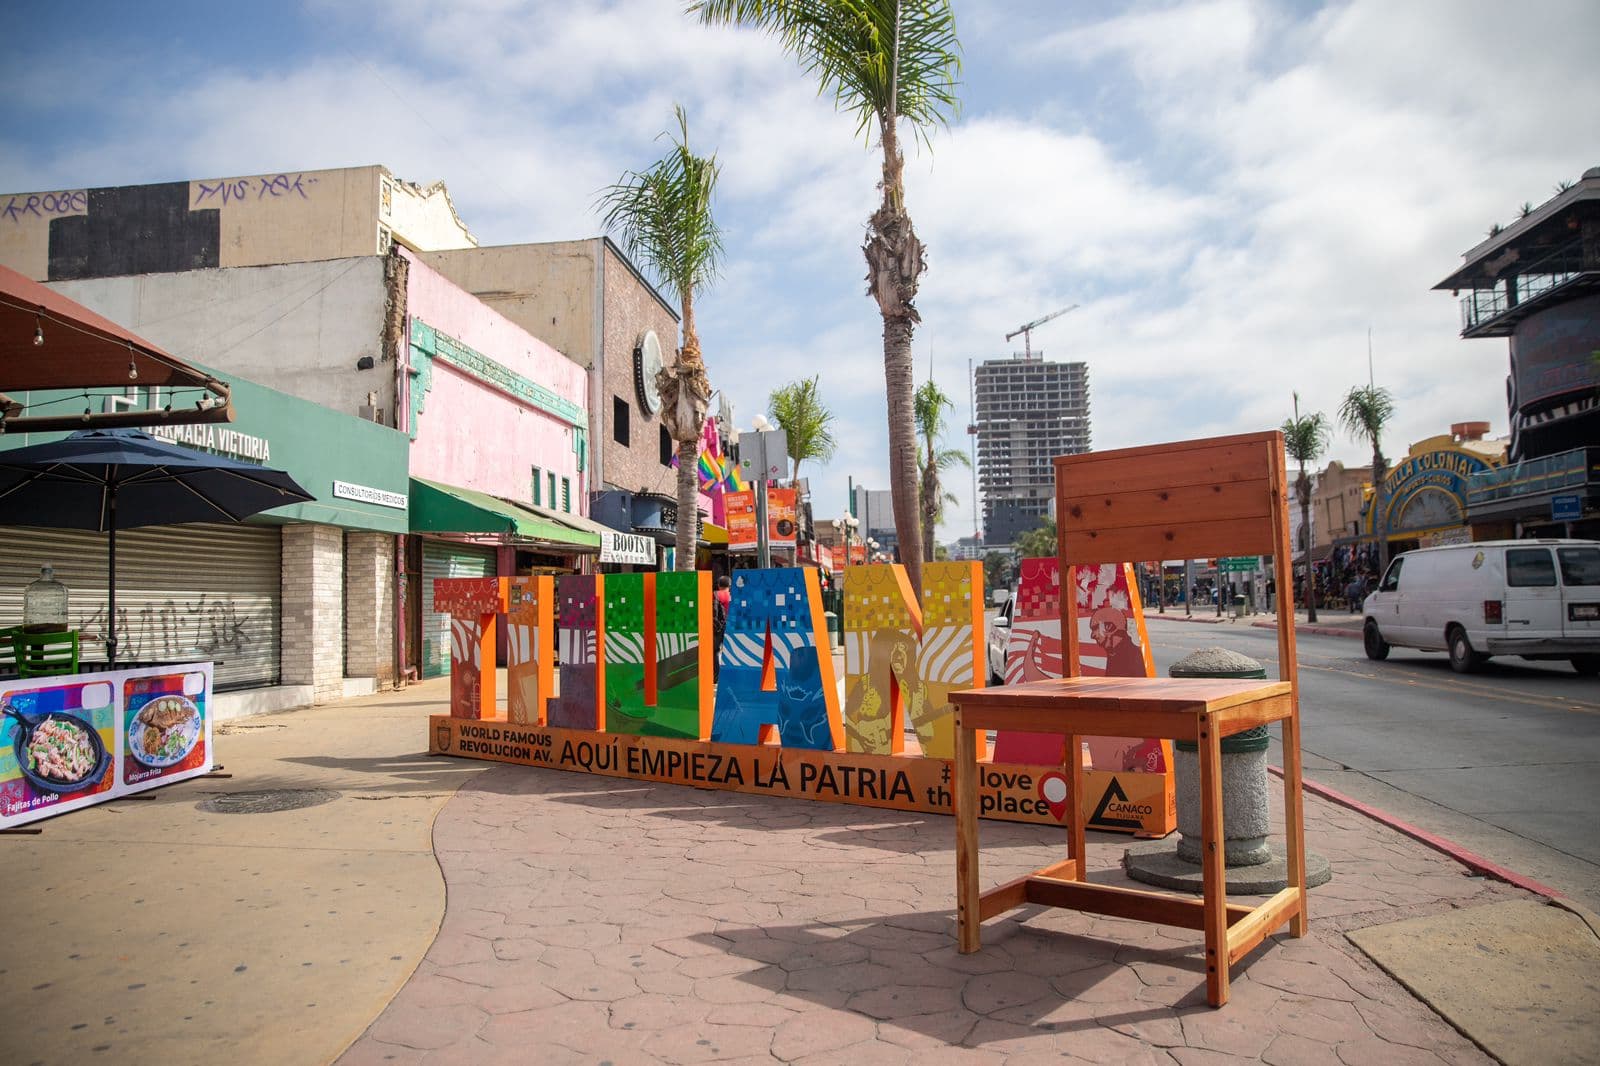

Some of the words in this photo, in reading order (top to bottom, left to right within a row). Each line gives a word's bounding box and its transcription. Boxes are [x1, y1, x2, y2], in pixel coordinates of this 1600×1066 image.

[218, 427, 270, 460] VICTORIA
[1384, 461, 1413, 494] VILLA
[1416, 452, 1472, 478] COLONIAL
[613, 533, 645, 553] BOOTS
[460, 725, 500, 741] WORLD
[503, 731, 552, 746] FAMOUS
[460, 740, 531, 760] REVOLUCION
[534, 750, 553, 763] AV.
[149, 768, 162, 777] Frita
[560, 737, 619, 772] AQUÍ
[627, 747, 744, 785] EMPIEZA
[753, 758, 790, 790] LA
[800, 762, 915, 802] PATRIA
[980, 766, 1032, 790] love
[7, 800, 31, 813] Fajitas
[31, 797, 41, 806] de
[42, 792, 59, 804] Pollo
[926, 785, 953, 807] th
[980, 790, 1050, 816] place
[1108, 803, 1153, 815] CANACO
